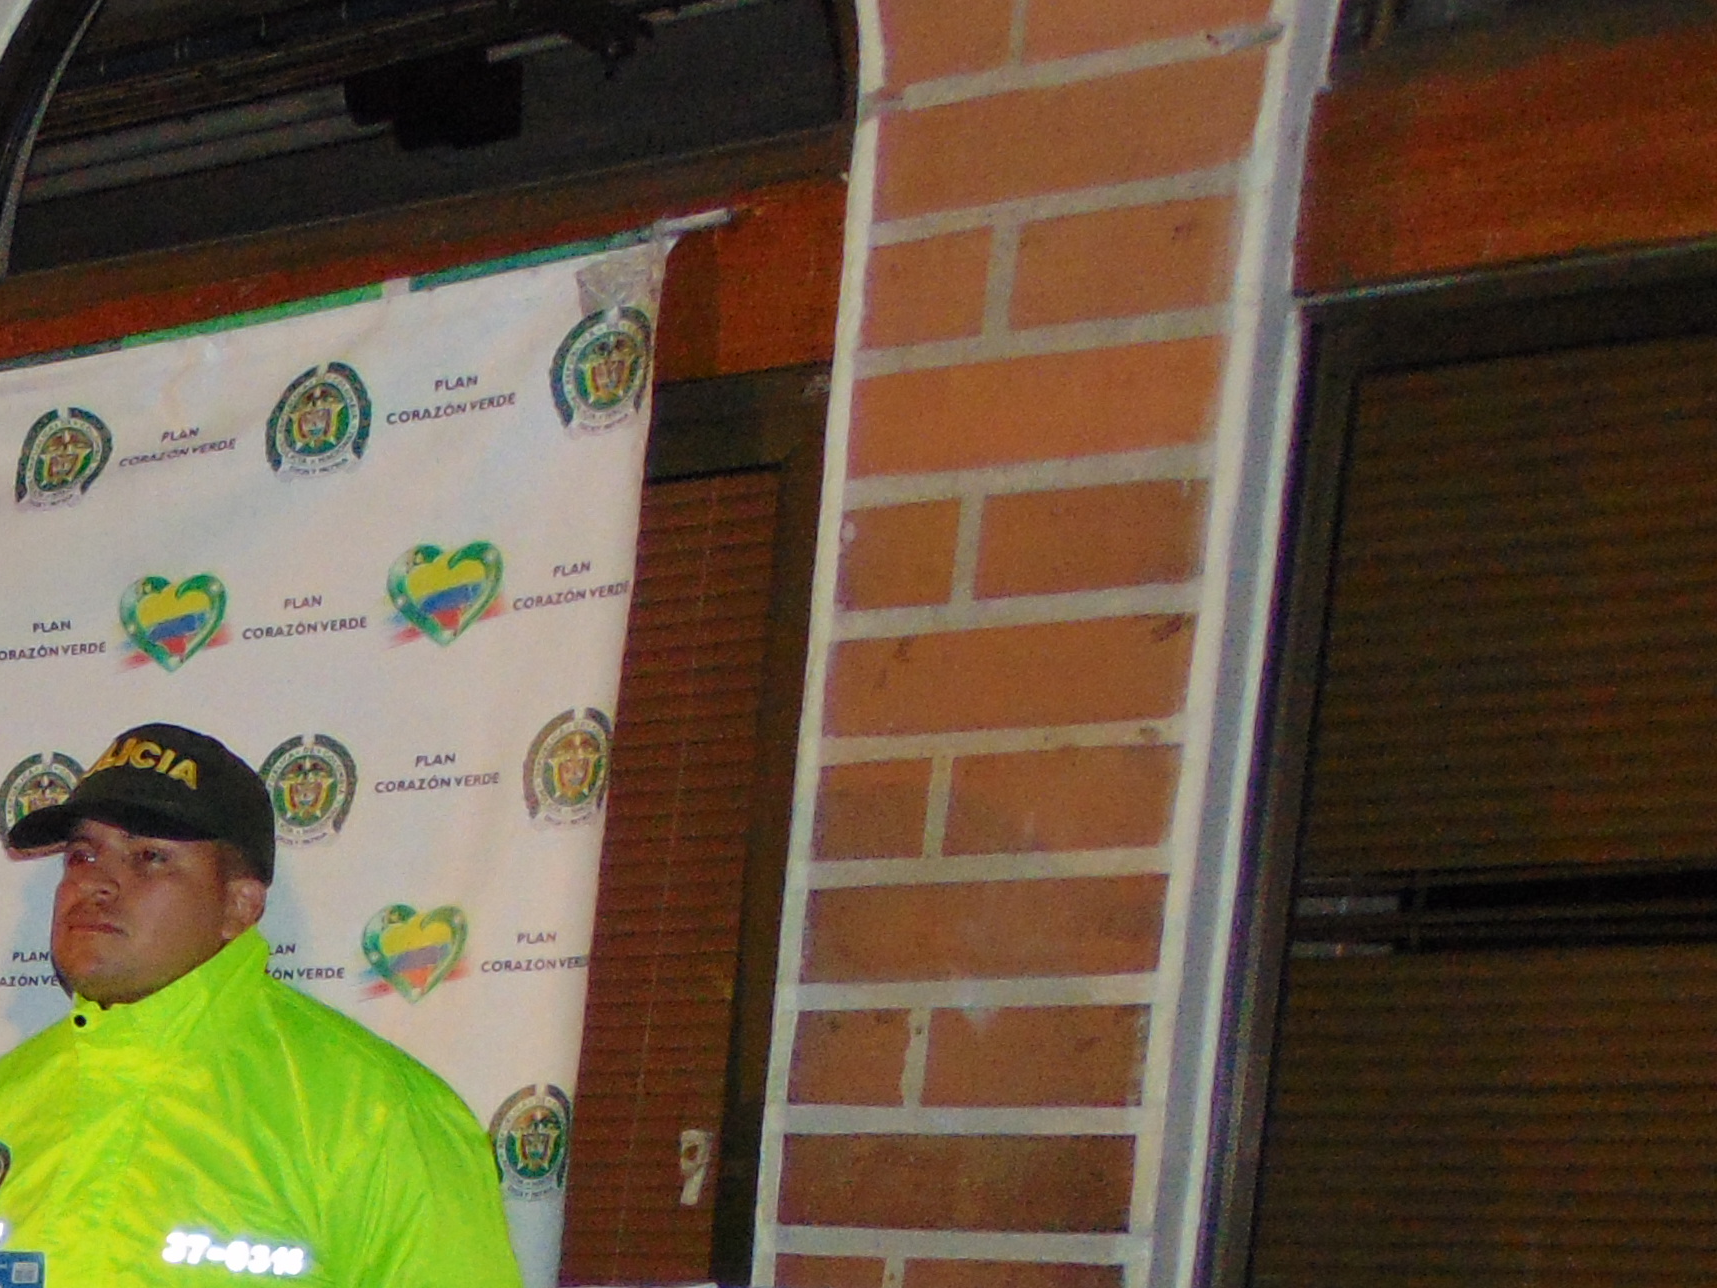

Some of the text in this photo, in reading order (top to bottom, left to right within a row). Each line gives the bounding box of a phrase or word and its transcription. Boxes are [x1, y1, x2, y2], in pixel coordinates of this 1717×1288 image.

[434, 375, 478, 392] PLAN
[470, 392, 516, 410] VERDE
[161, 427, 199, 442] PLAN
[191, 438, 237, 454] VERDE
[553, 561, 591, 577] PLAN
[283, 596, 322, 610] PLAN
[32, 620, 70, 633] PLAN
[320, 617, 366, 630] VERDE
[63, 642, 106, 655] VERDE
[84, 737, 198, 790] LICIA
[415, 753, 456, 767] PLAN
[454, 772, 500, 786] VERDE
[517, 932, 557, 944] PLAN
[12, 950, 50, 963] PLAN
[297, 967, 345, 979] VERDE
